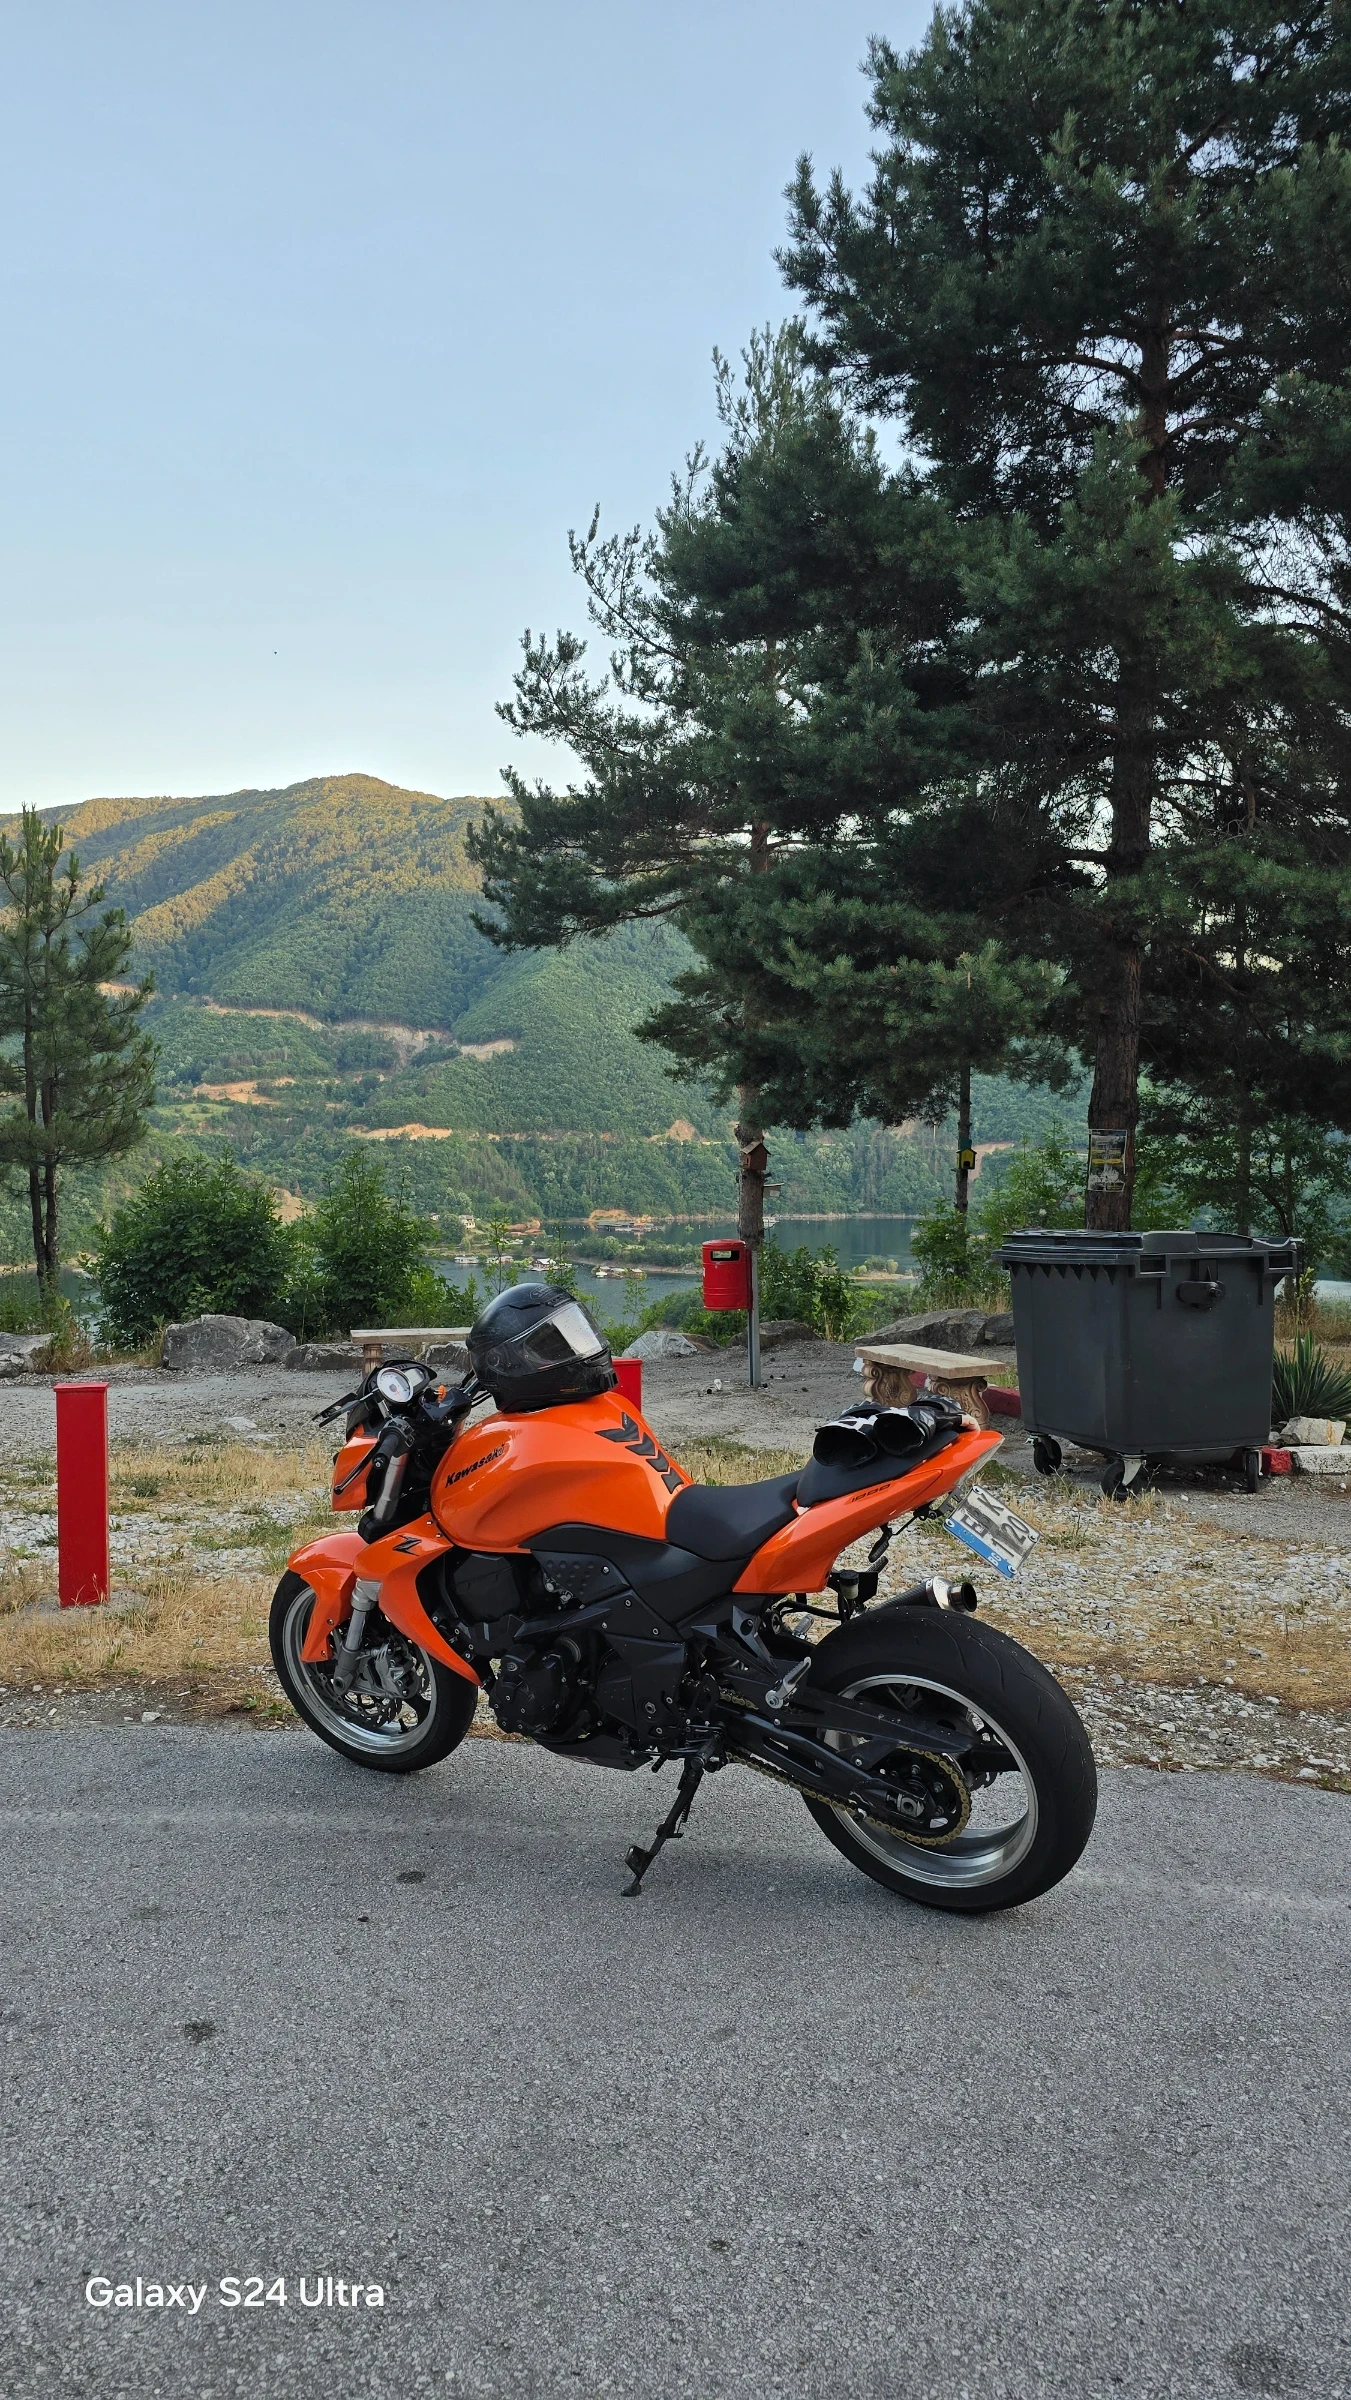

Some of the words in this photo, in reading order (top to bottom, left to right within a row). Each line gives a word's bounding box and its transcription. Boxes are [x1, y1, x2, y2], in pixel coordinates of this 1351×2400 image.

[445, 1443, 506, 1488] Kawasaki
[977, 1492, 1004, 1516] K
[987, 1551, 1002, 1567] BG
